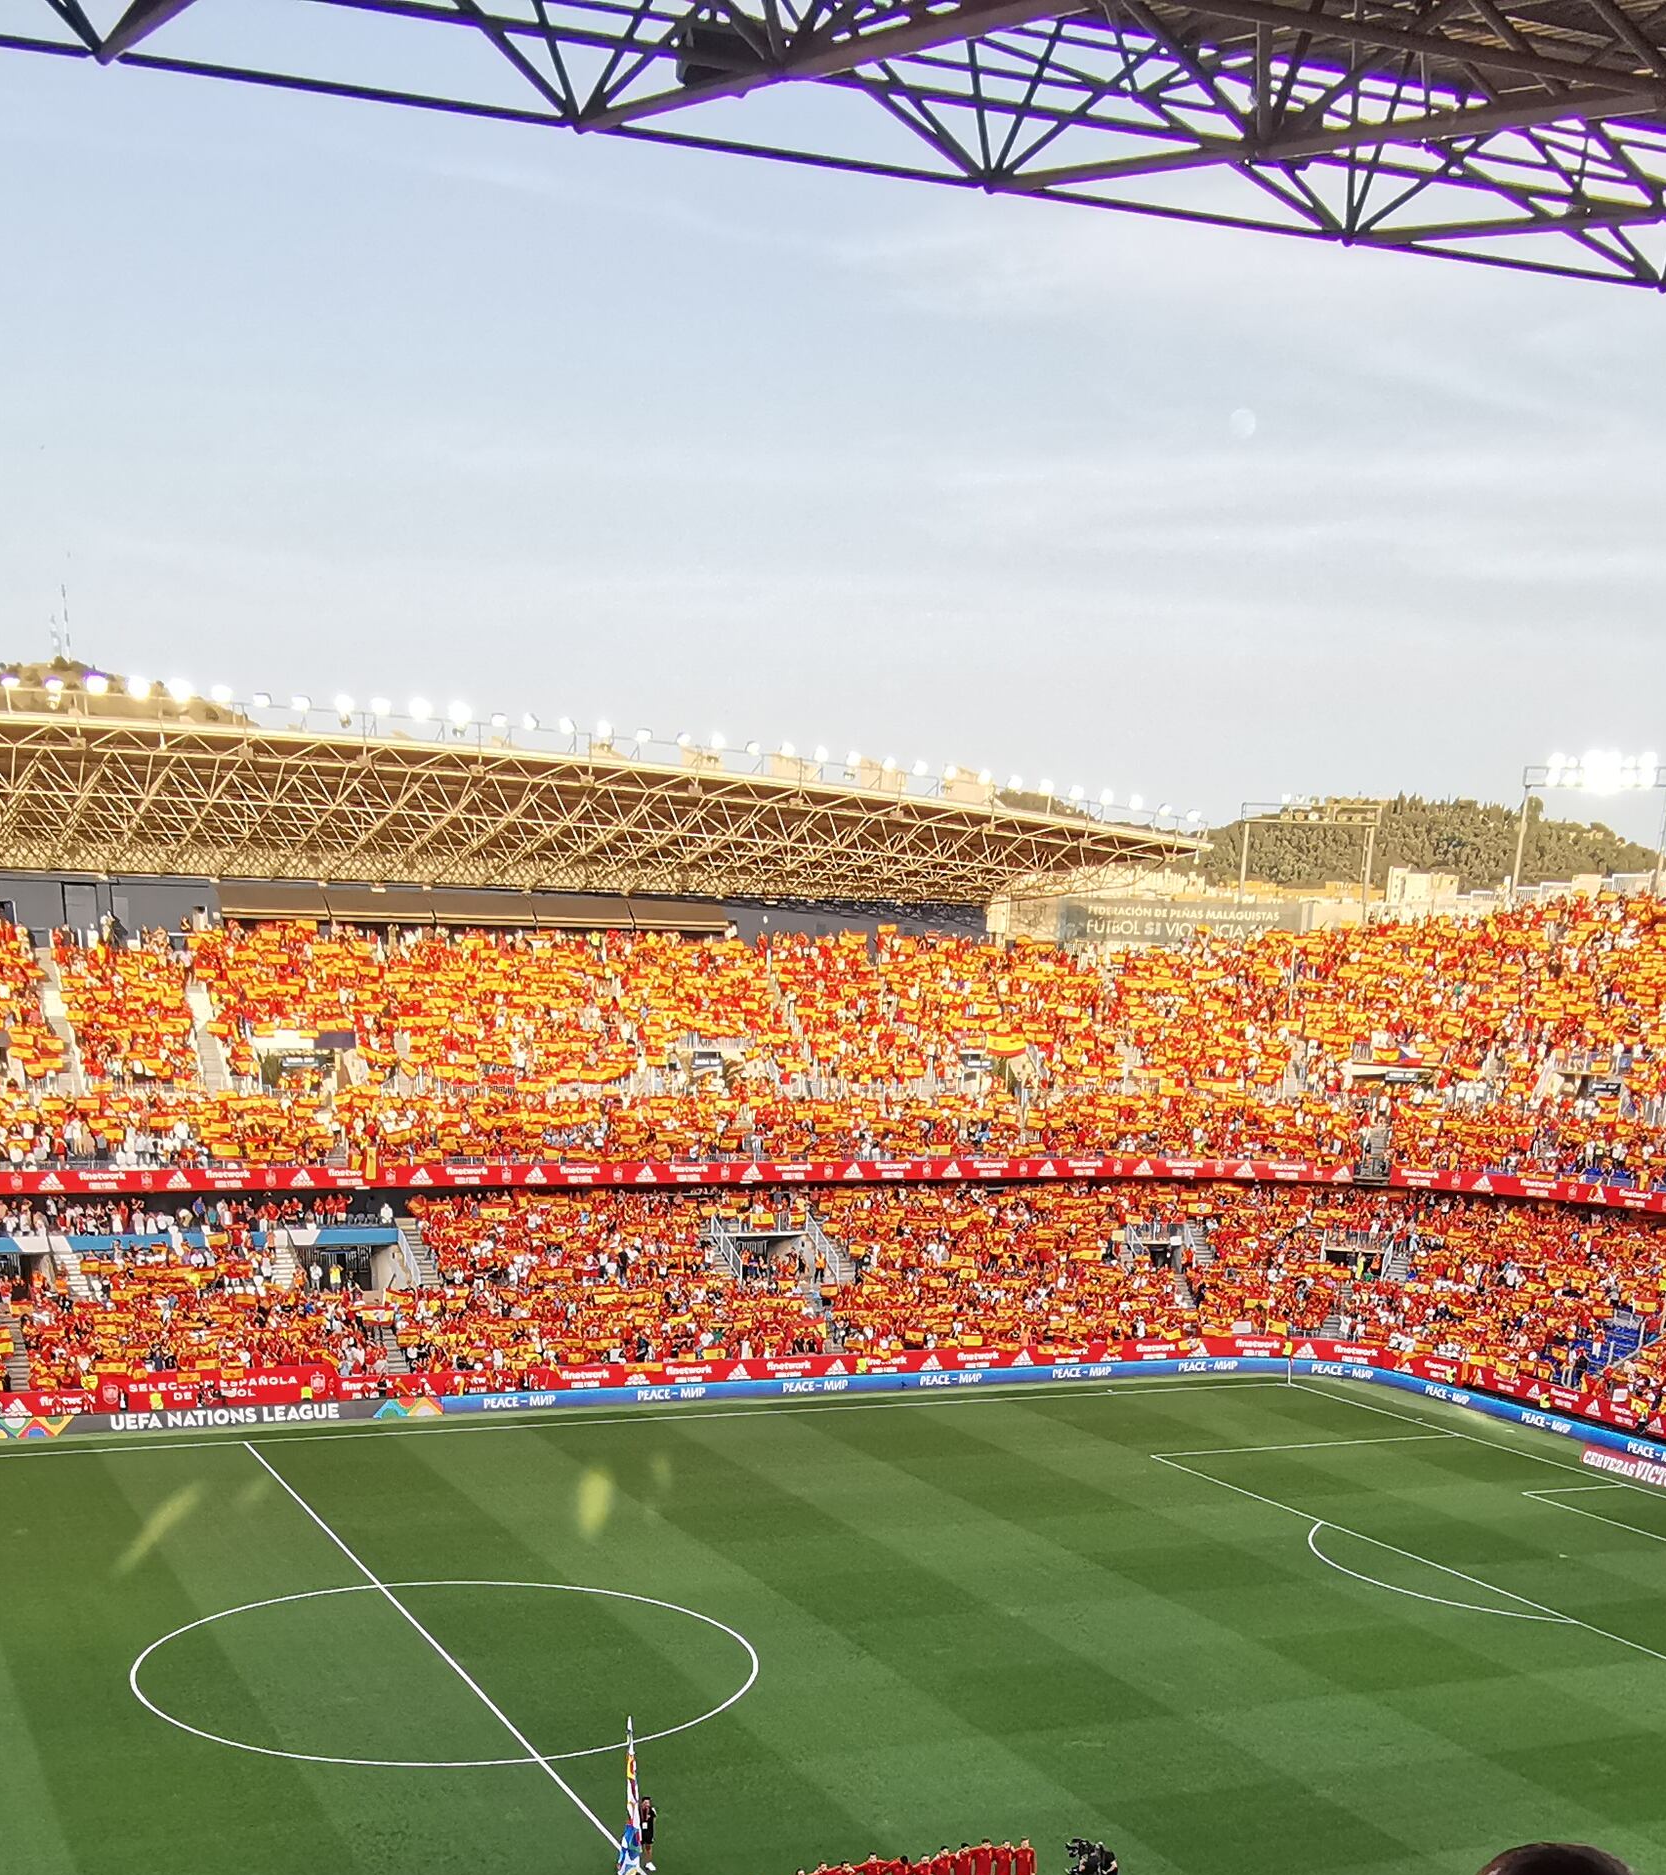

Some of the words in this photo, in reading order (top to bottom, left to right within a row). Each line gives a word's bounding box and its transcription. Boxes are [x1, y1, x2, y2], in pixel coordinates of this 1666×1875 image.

[1088, 904, 1151, 918] FEDERACIÓN
[1154, 908, 1168, 918] DE
[1171, 907, 1203, 919] PEÑAS
[1206, 910, 1280, 921] MALAGUISTAS
[1086, 918, 1141, 935] FÚTBOL
[1165, 922, 1246, 938] VIONCIA
[328, 1168, 363, 1177] finetwo
[173, 1392, 192, 1402] DE
[110, 1413, 161, 1431] UEFA
[167, 1406, 256, 1428] NATIONS
[262, 1403, 340, 1422] LEAGUE
[1583, 1450, 1635, 1478] CERVEZAS
